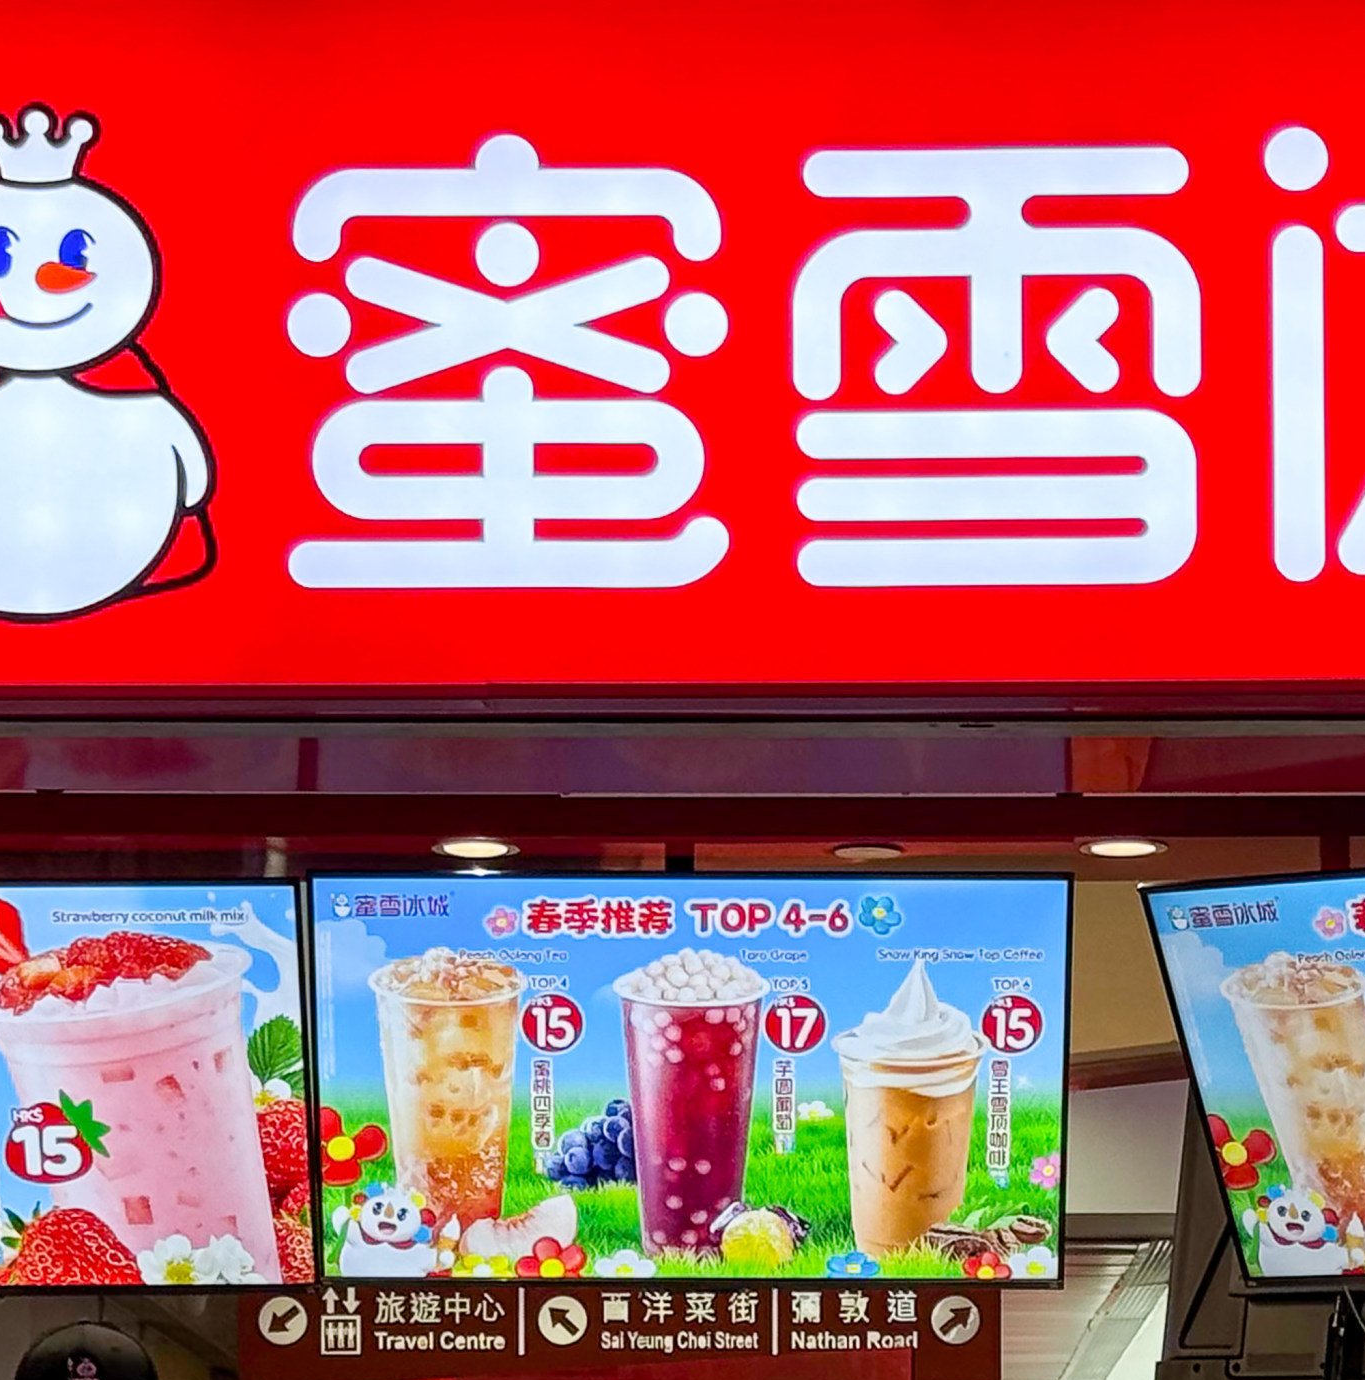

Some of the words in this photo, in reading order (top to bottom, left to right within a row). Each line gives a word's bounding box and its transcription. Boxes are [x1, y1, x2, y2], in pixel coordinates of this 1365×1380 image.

[52, 911, 129, 924] Strawberry
[132, 911, 187, 922] coconut
[190, 910, 217, 922] milk
[221, 911, 244, 921] mix
[355, 895, 449, 917] 蜜雪冰城
[527, 899, 673, 936] 春季推荐
[691, 903, 771, 933] TOP
[782, 903, 849, 933] 4-6
[1188, 901, 1279, 928] 蜜雪冰城
[529, 978, 556, 990] TOP
[993, 978, 1018, 991] TOP
[533, 1007, 573, 1048] 15
[777, 1007, 818, 1049] 17
[993, 1007, 1035, 1049] 15
[991, 1060, 1007, 1167] 雪王雪顶咖啡
[12, 1125, 83, 1176] 15
[375, 1293, 506, 1325] 旅遊中心
[790, 1291, 918, 1324] 彌敦道
[375, 1332, 434, 1350] Travel
[440, 1332, 506, 1350] Centre
[628, 1332, 674, 1354] Yeung
[715, 1332, 759, 1350] Street
[791, 1332, 862, 1350] Nathan
[867, 1332, 918, 1350] Road
